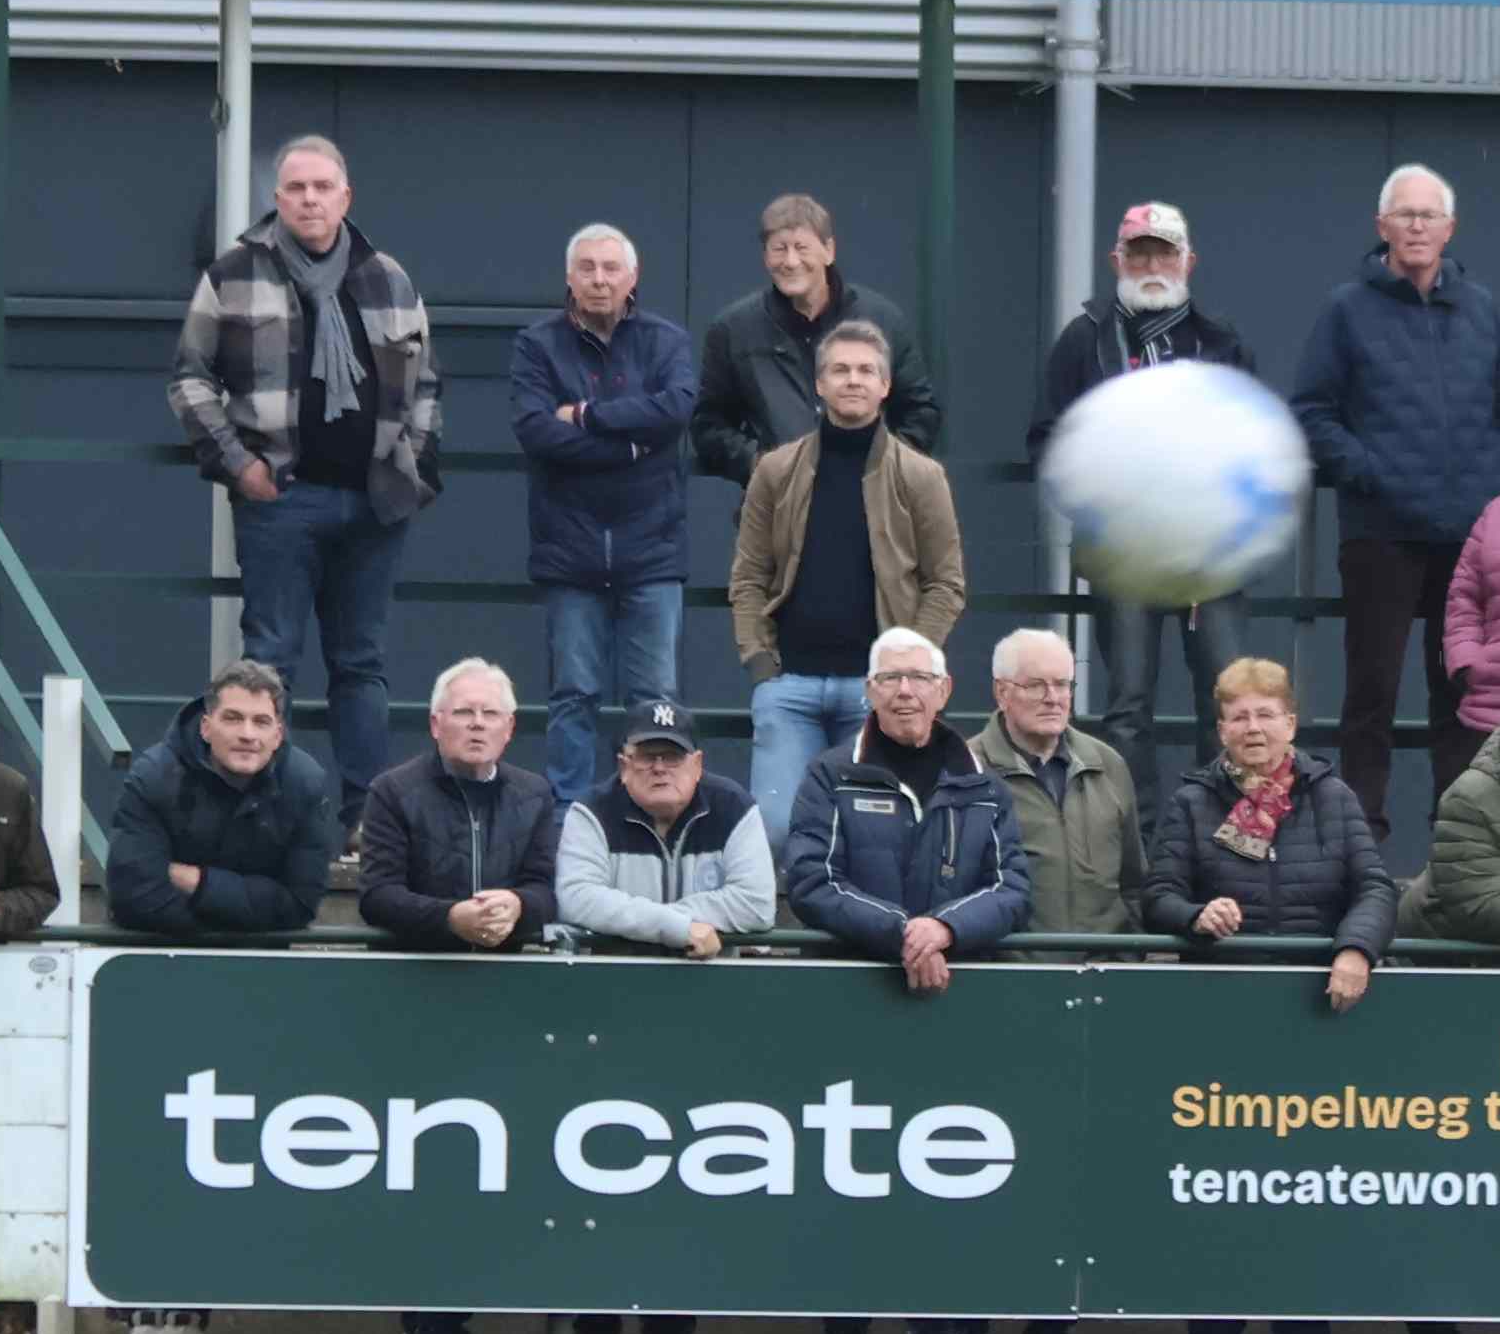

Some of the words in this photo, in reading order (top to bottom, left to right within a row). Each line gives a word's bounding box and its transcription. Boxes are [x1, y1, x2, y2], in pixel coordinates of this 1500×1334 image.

[164, 1069, 508, 1192] ten
[553, 1079, 1016, 1200] cate
[1172, 1082, 1472, 1140] Simpelweg
